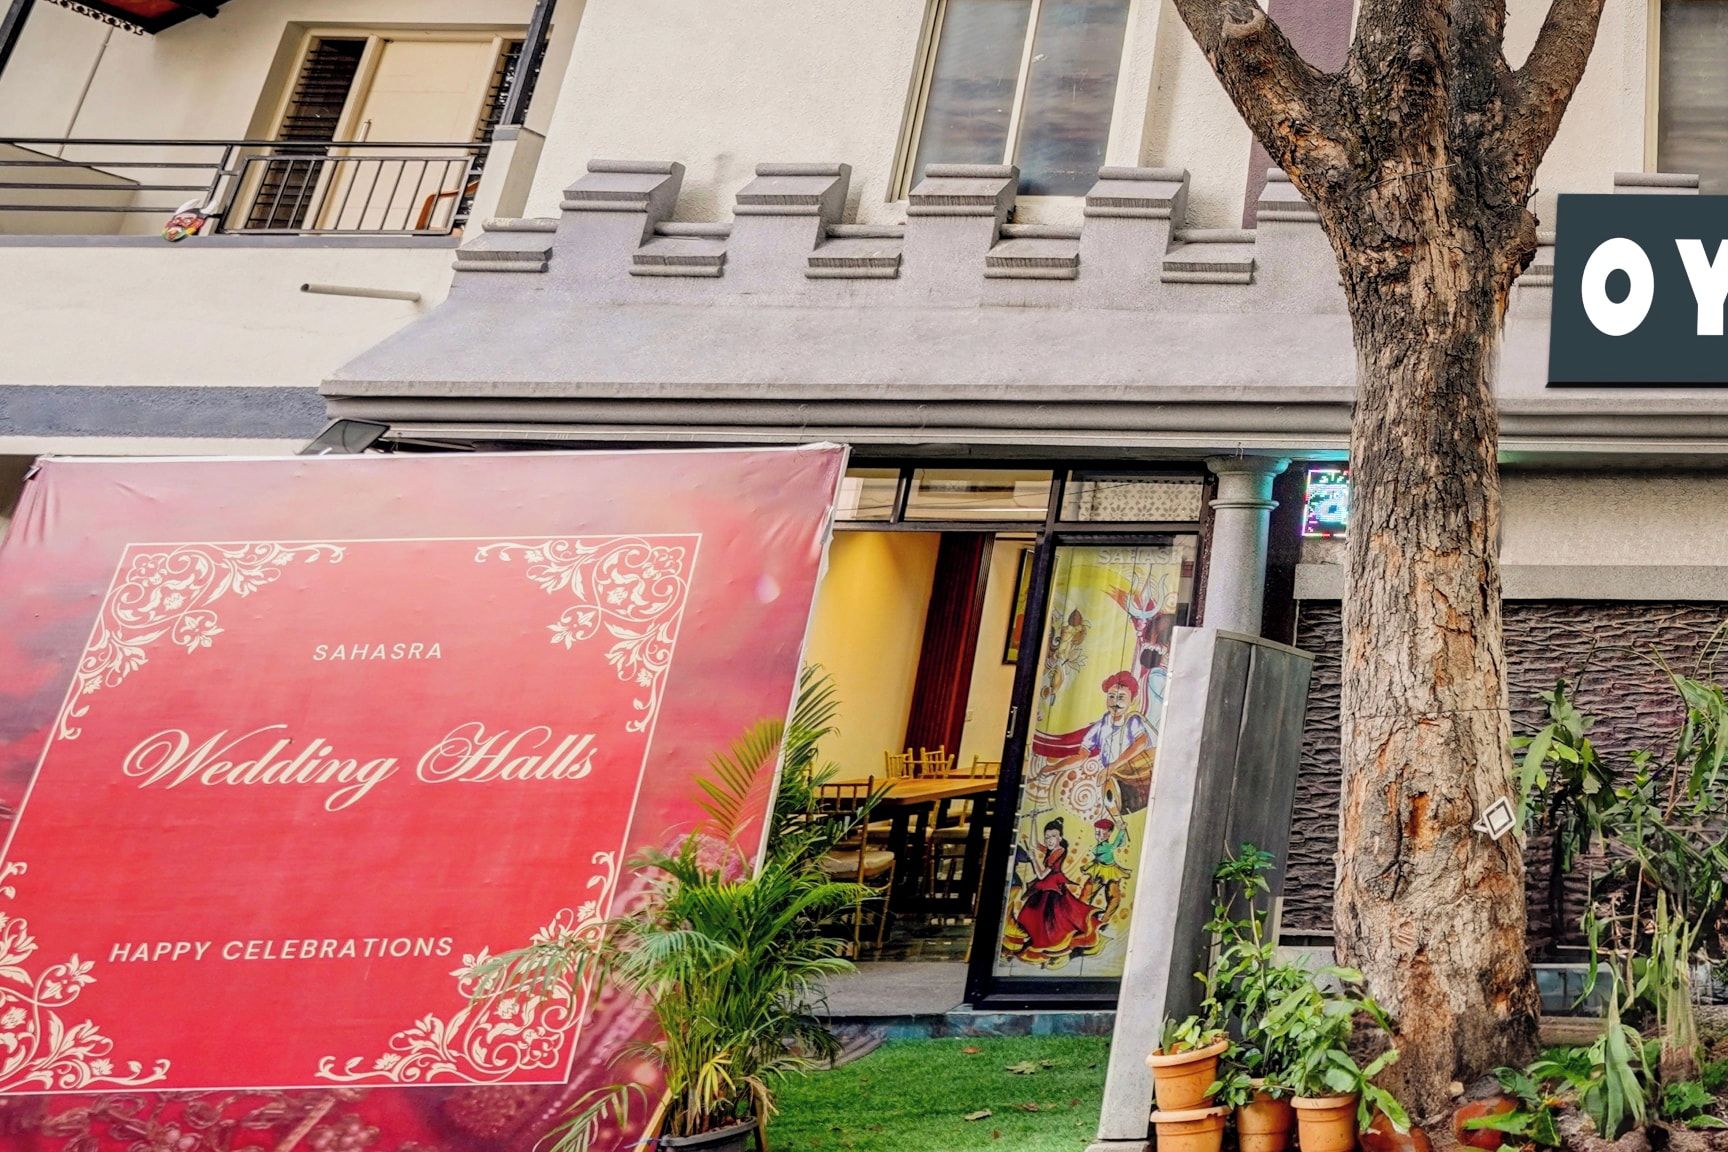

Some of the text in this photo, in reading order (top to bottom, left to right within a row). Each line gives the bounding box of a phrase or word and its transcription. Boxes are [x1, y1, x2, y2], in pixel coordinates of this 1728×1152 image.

[312, 642, 443, 662] SAHASRA
[122, 721, 597, 813] Wedding Halls
[109, 936, 454, 963] HAPPY CELEBRATIONS
